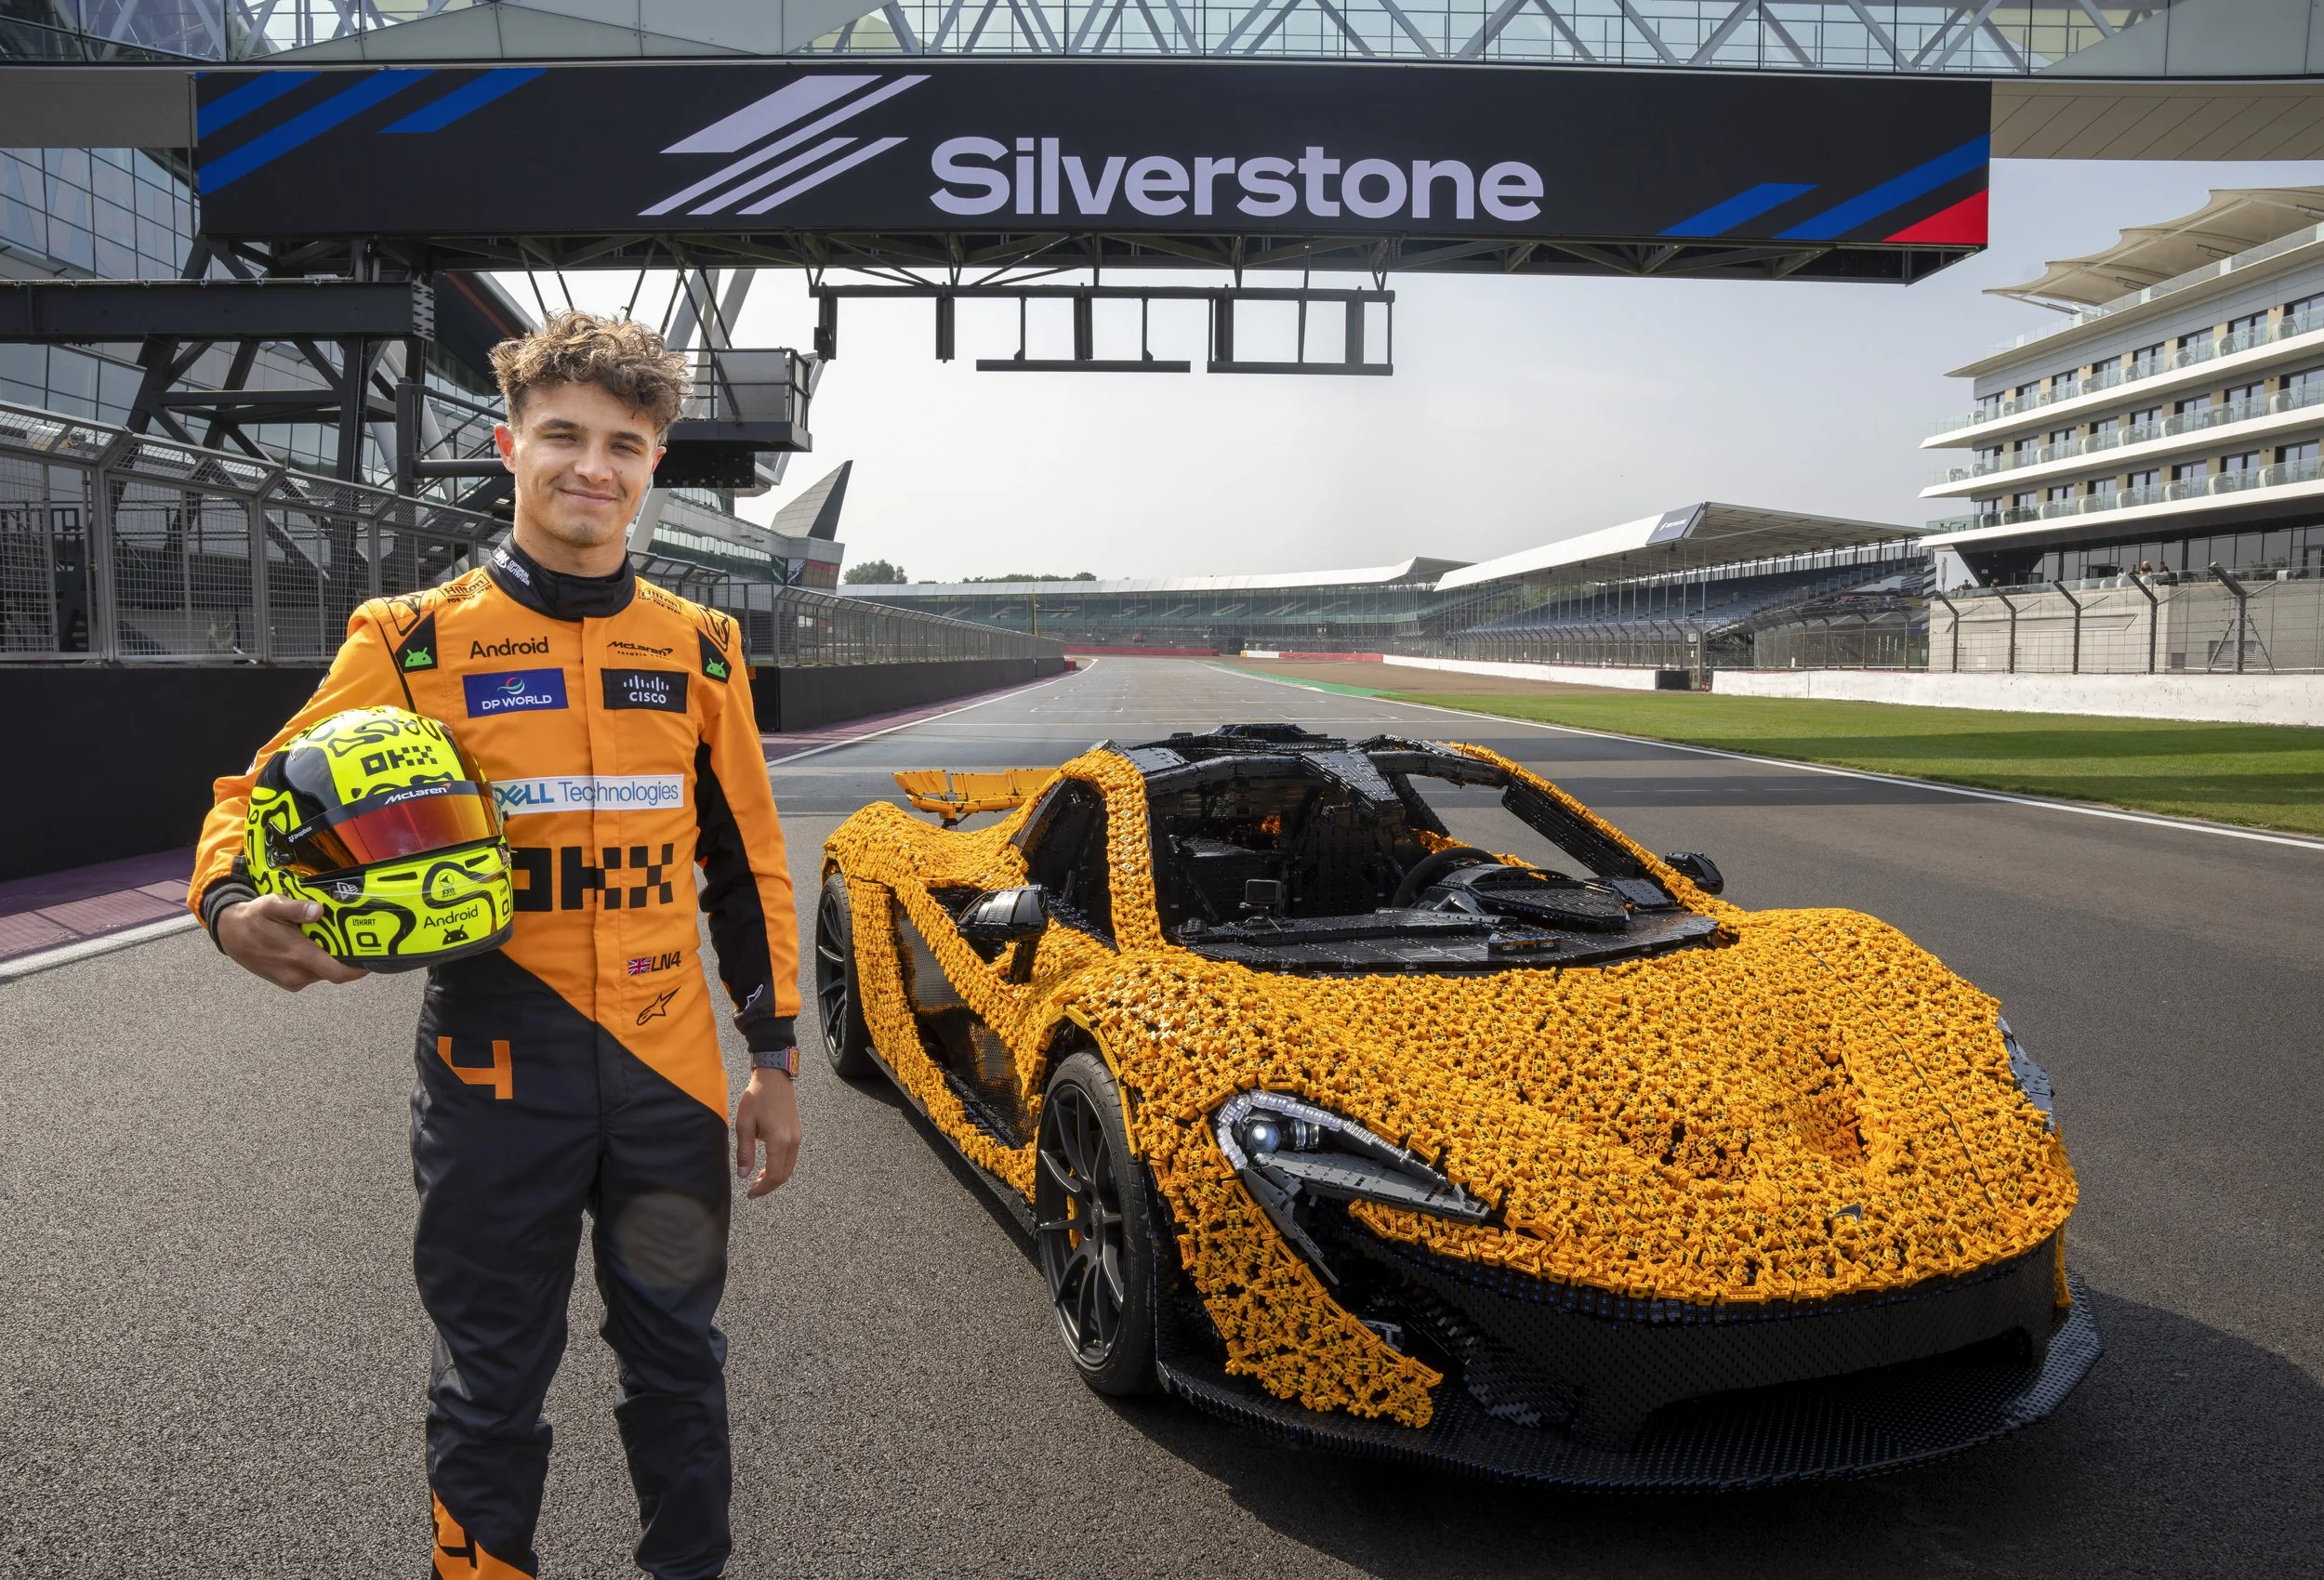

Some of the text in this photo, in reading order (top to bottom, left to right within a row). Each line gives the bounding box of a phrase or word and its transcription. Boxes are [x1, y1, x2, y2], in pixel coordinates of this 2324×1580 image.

[930, 137, 1544, 222] Silverstone
[443, 578, 484, 595] Hilton
[469, 636, 549, 659] Android
[606, 640, 667, 656] McLaren
[482, 693, 552, 710] DP WORLD
[628, 691, 667, 704] CISCO
[384, 786, 448, 805] McLaren
[558, 781, 680, 806] Technologies
[294, 826, 312, 839] Dropbox
[423, 904, 479, 928] Android
[651, 951, 681, 972] LN4
[437, 1035, 513, 1099] 4
